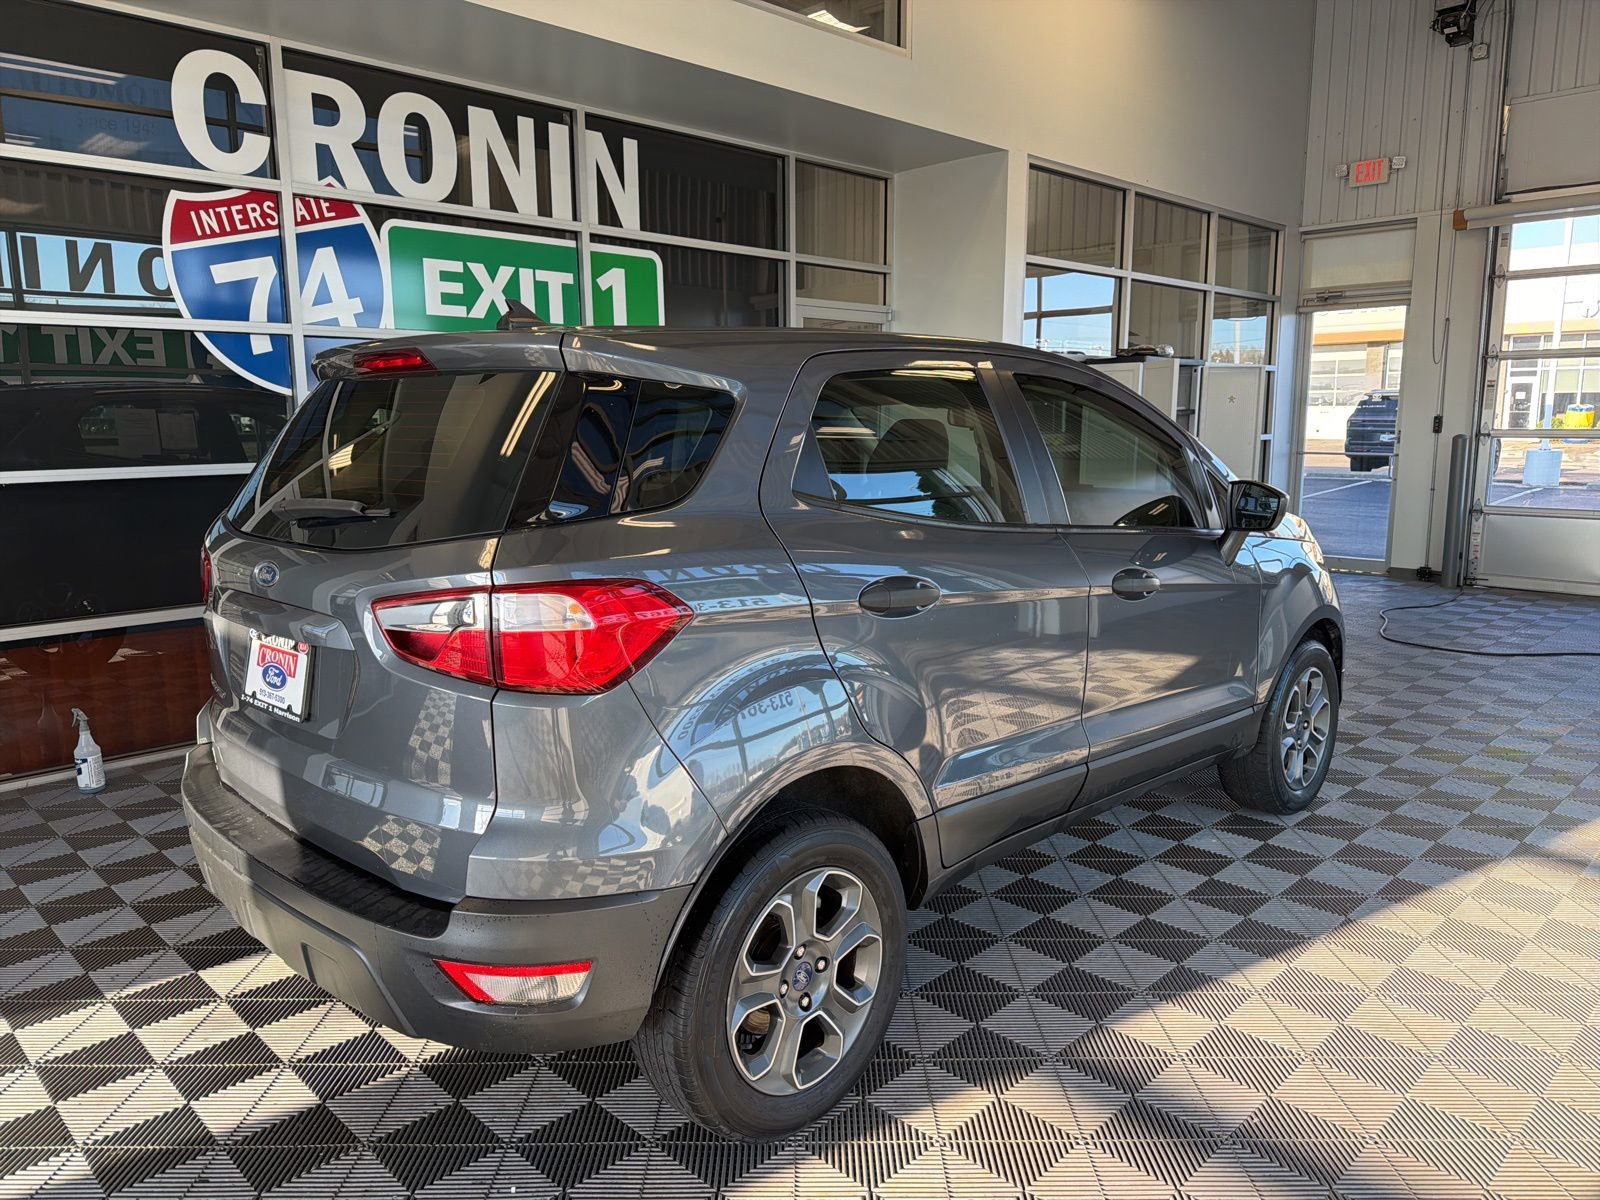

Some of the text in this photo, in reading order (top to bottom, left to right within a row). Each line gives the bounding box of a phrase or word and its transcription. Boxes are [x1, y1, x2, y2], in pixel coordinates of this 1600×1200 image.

[171, 49, 641, 232] CRONIN
[1355, 159, 1384, 185] EXIT
[190, 197, 336, 236] INTERSATE
[209, 246, 364, 355] 74
[423, 257, 628, 326] EXIT 1
[259, 646, 298, 678] CRONIN
[265, 666, 283, 687] Ford
[253, 698, 269, 710] EXIT
[273, 704, 301, 723] Harrison
